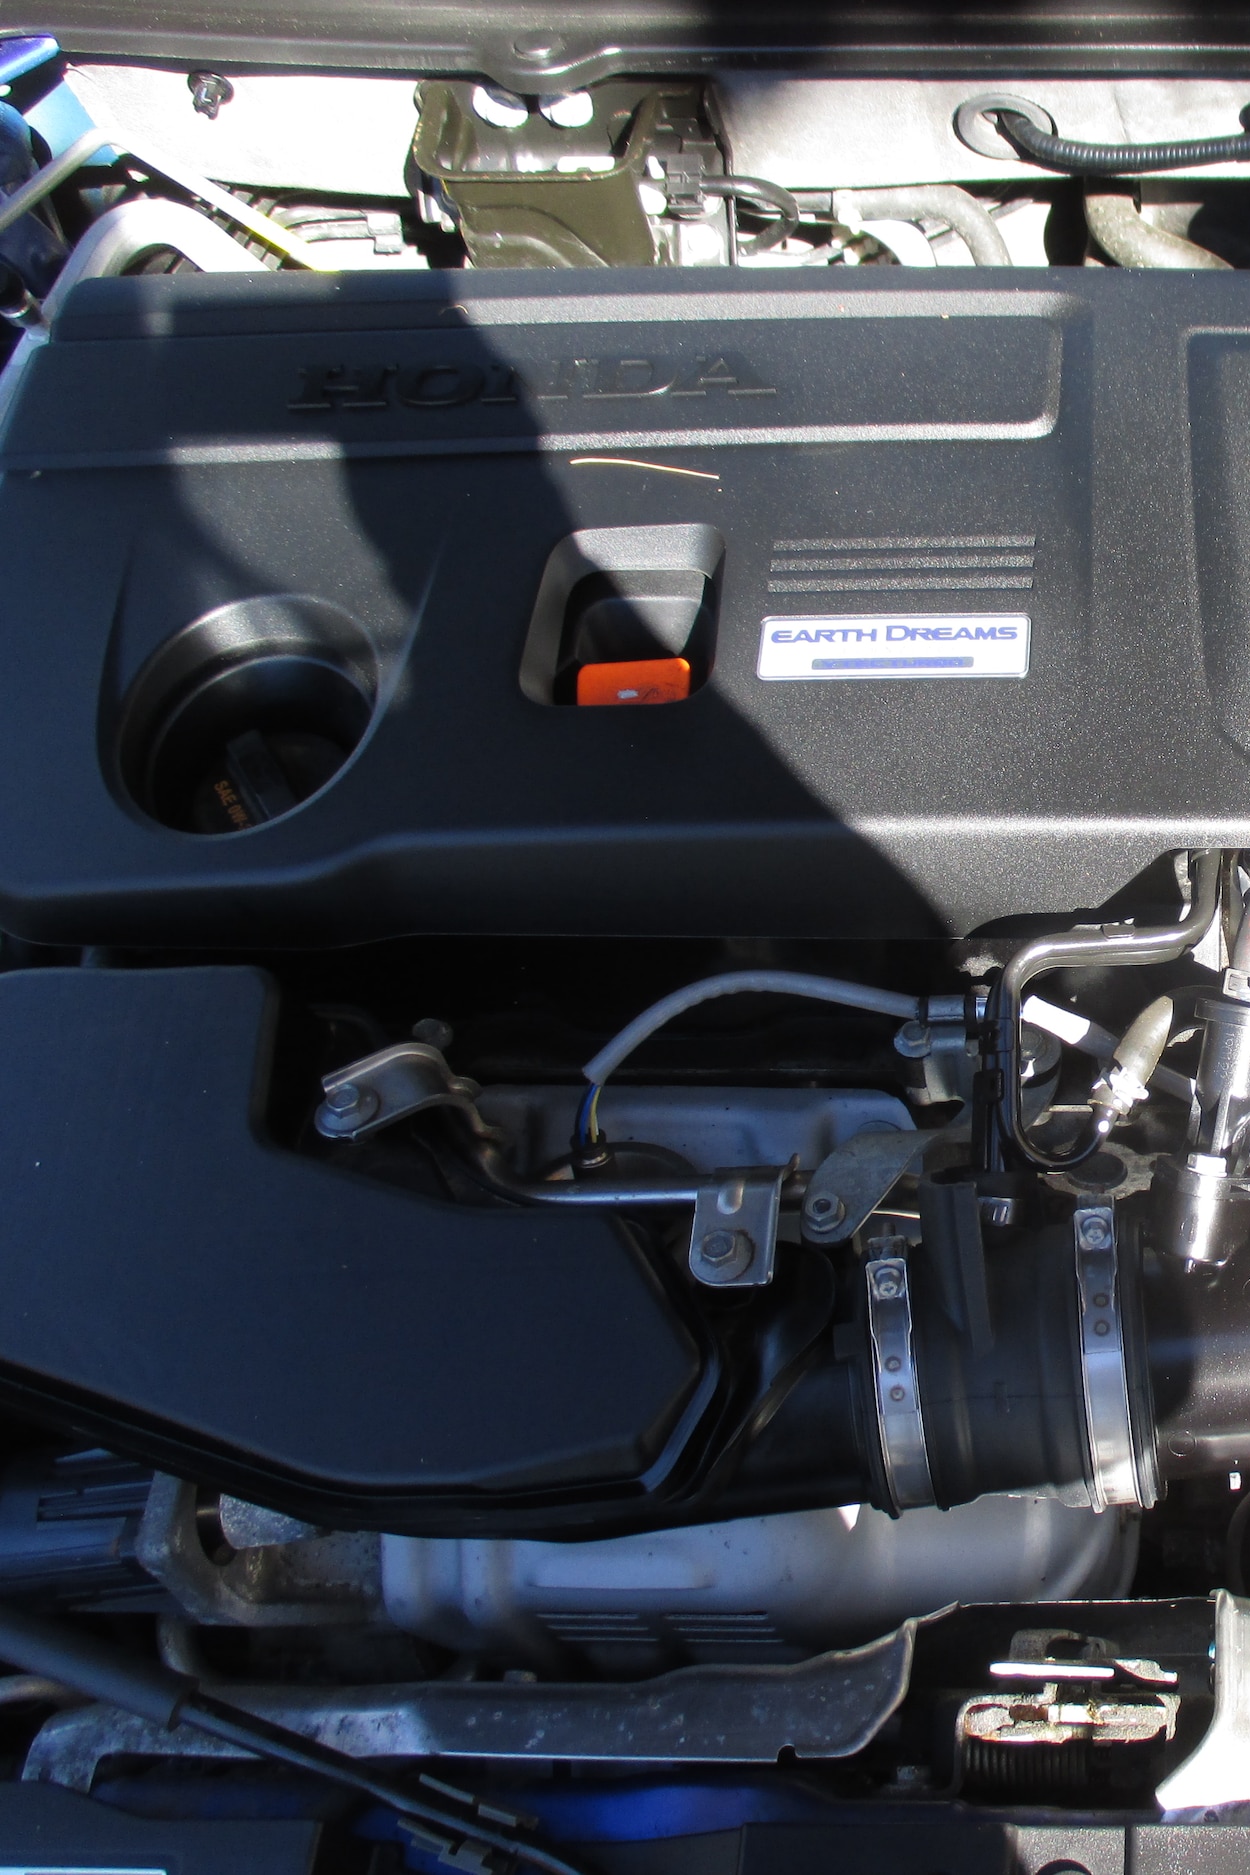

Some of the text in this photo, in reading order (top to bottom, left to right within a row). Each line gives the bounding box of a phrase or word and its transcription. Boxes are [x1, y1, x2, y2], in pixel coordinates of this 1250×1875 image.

[286, 355, 777, 411] HONDA
[771, 625, 1018, 643] EARTH DREAMS
[213, 779, 236, 807] SAE
